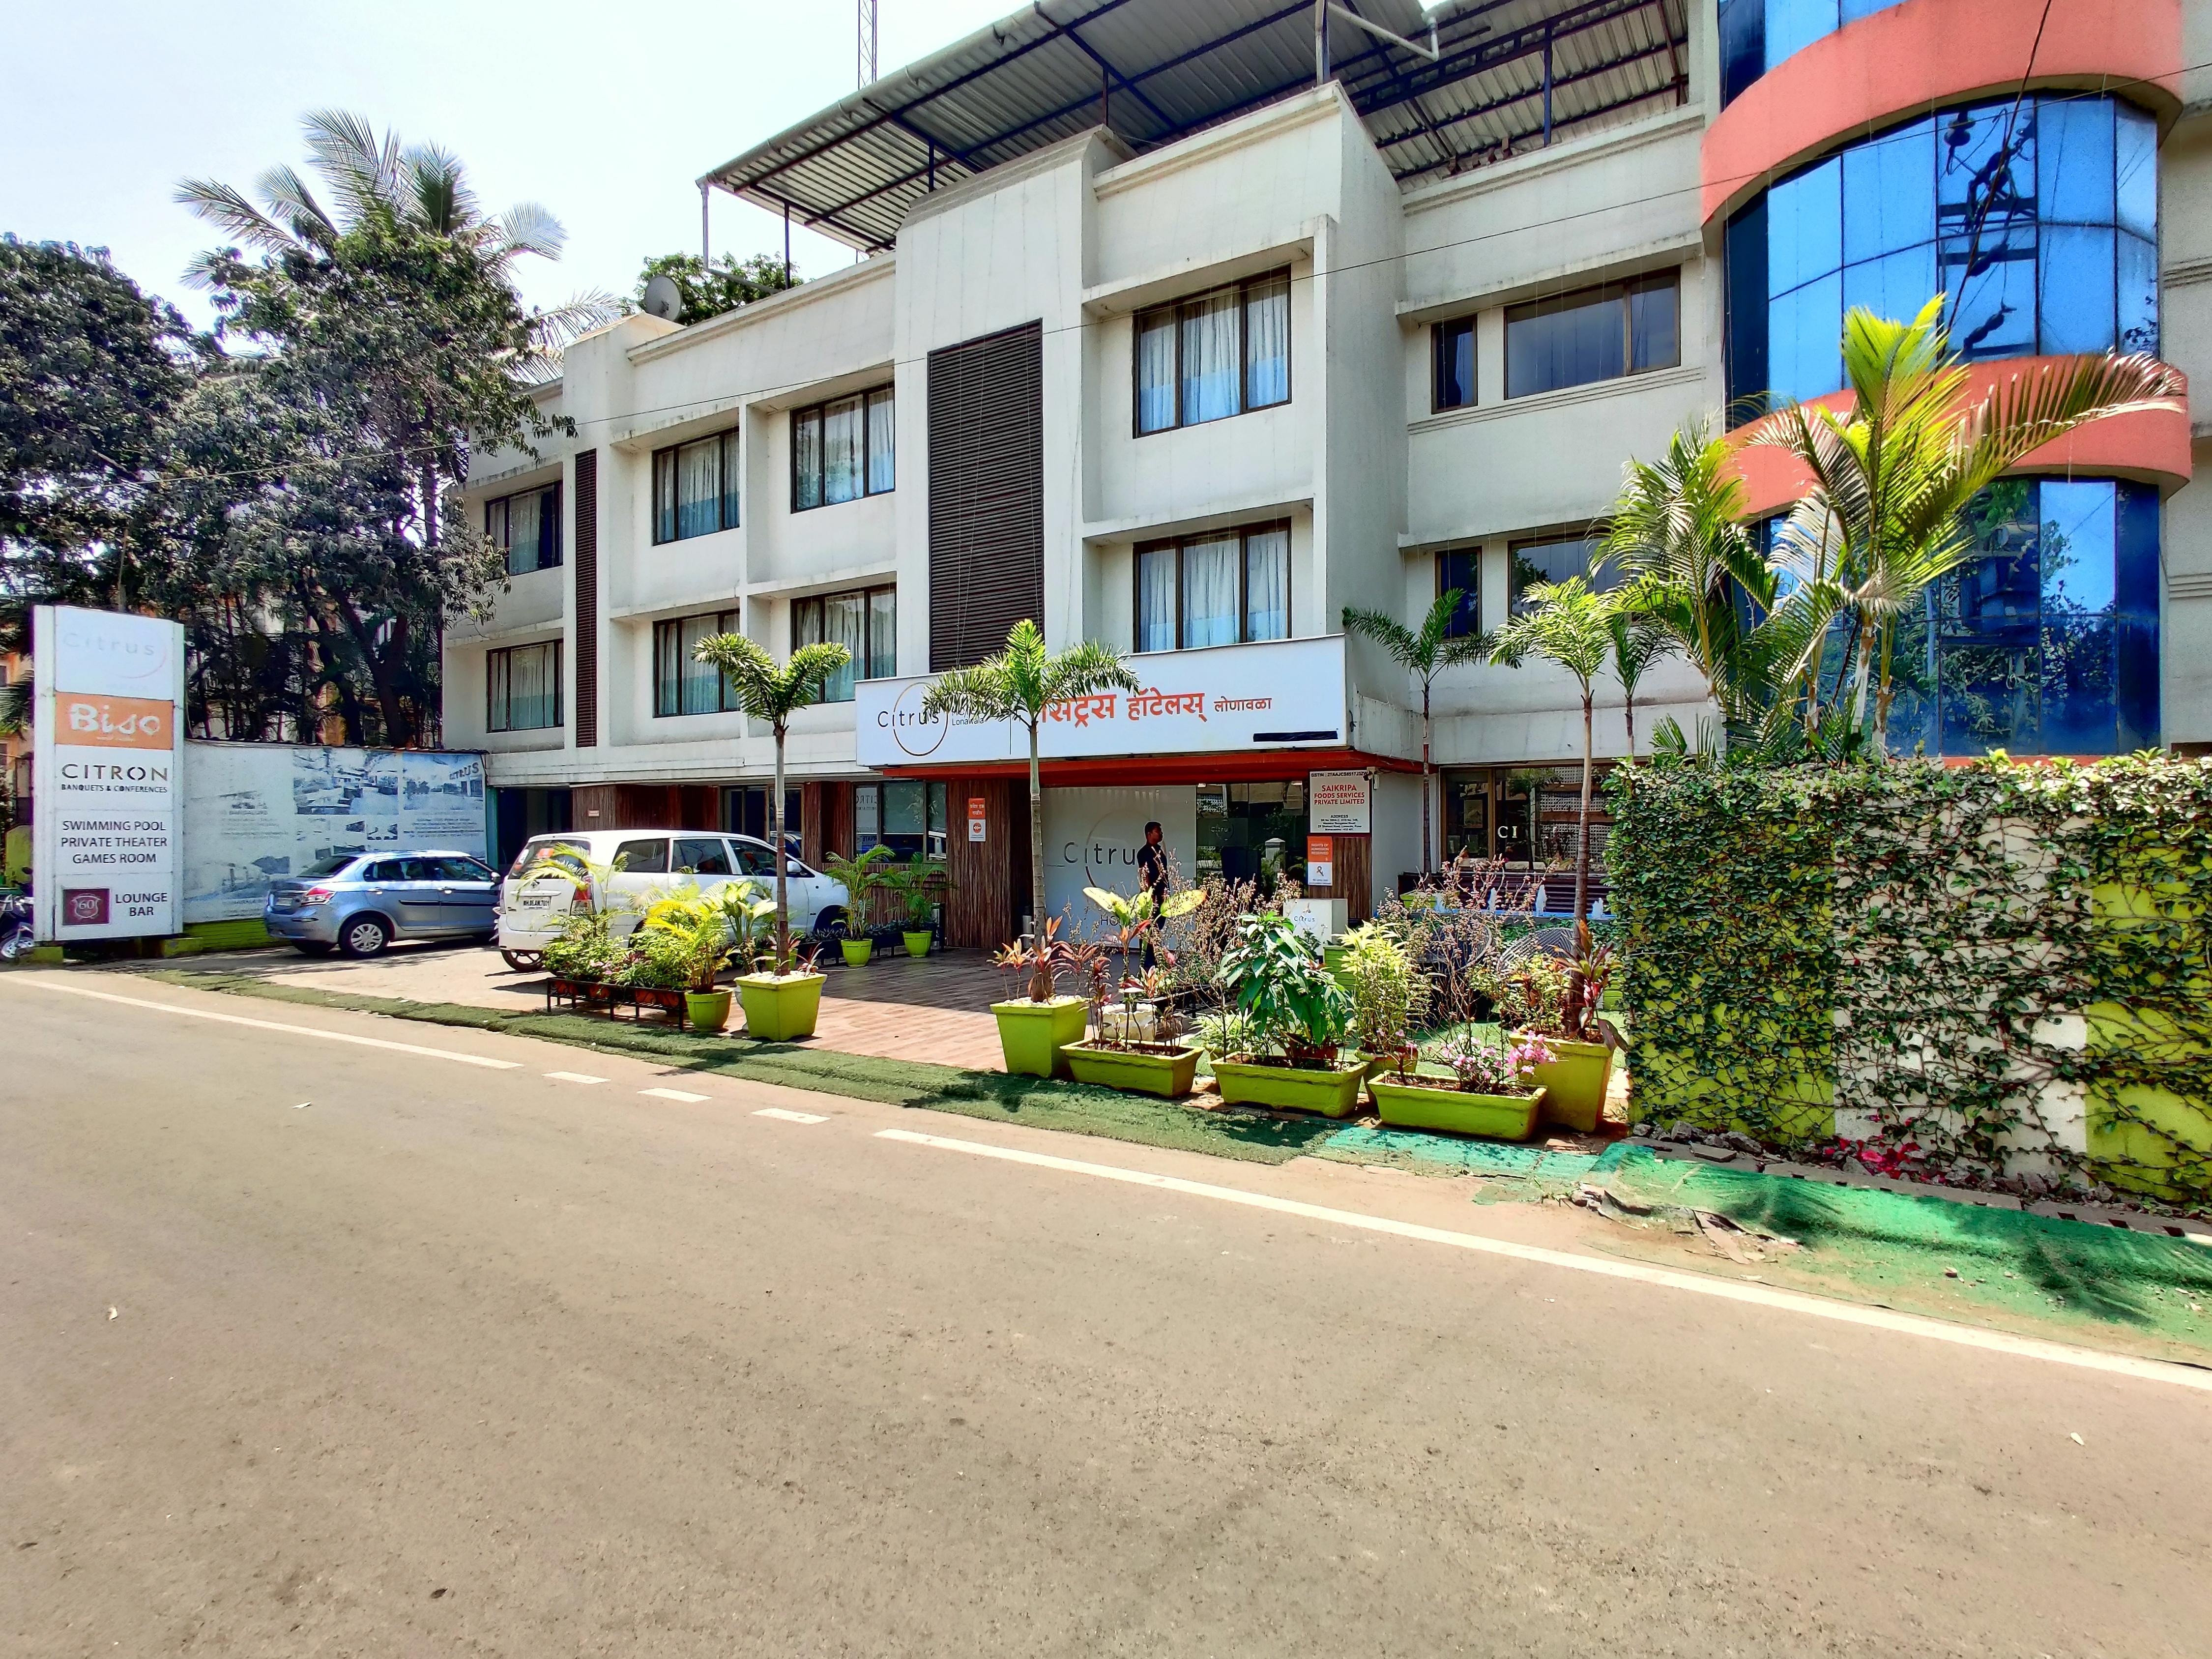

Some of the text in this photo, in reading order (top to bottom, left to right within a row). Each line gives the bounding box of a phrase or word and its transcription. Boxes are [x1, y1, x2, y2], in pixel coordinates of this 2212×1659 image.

[63, 633, 154, 656] Citrus
[1213, 696, 1272, 713] लोणावळा
[877, 710, 939, 728] Citrus
[952, 717, 984, 726] Lonawala
[62, 763, 168, 781] CITRON
[62, 820, 167, 831] SWIMMING POOL
[61, 837, 168, 847] PRIVATE THEATER
[73, 853, 156, 864] GAMES ROOM
[1064, 843, 1136, 865] Citru
[115, 892, 168, 903] LOUNGE
[79, 899, 95, 910] 60
[129, 906, 154, 917] BAR
